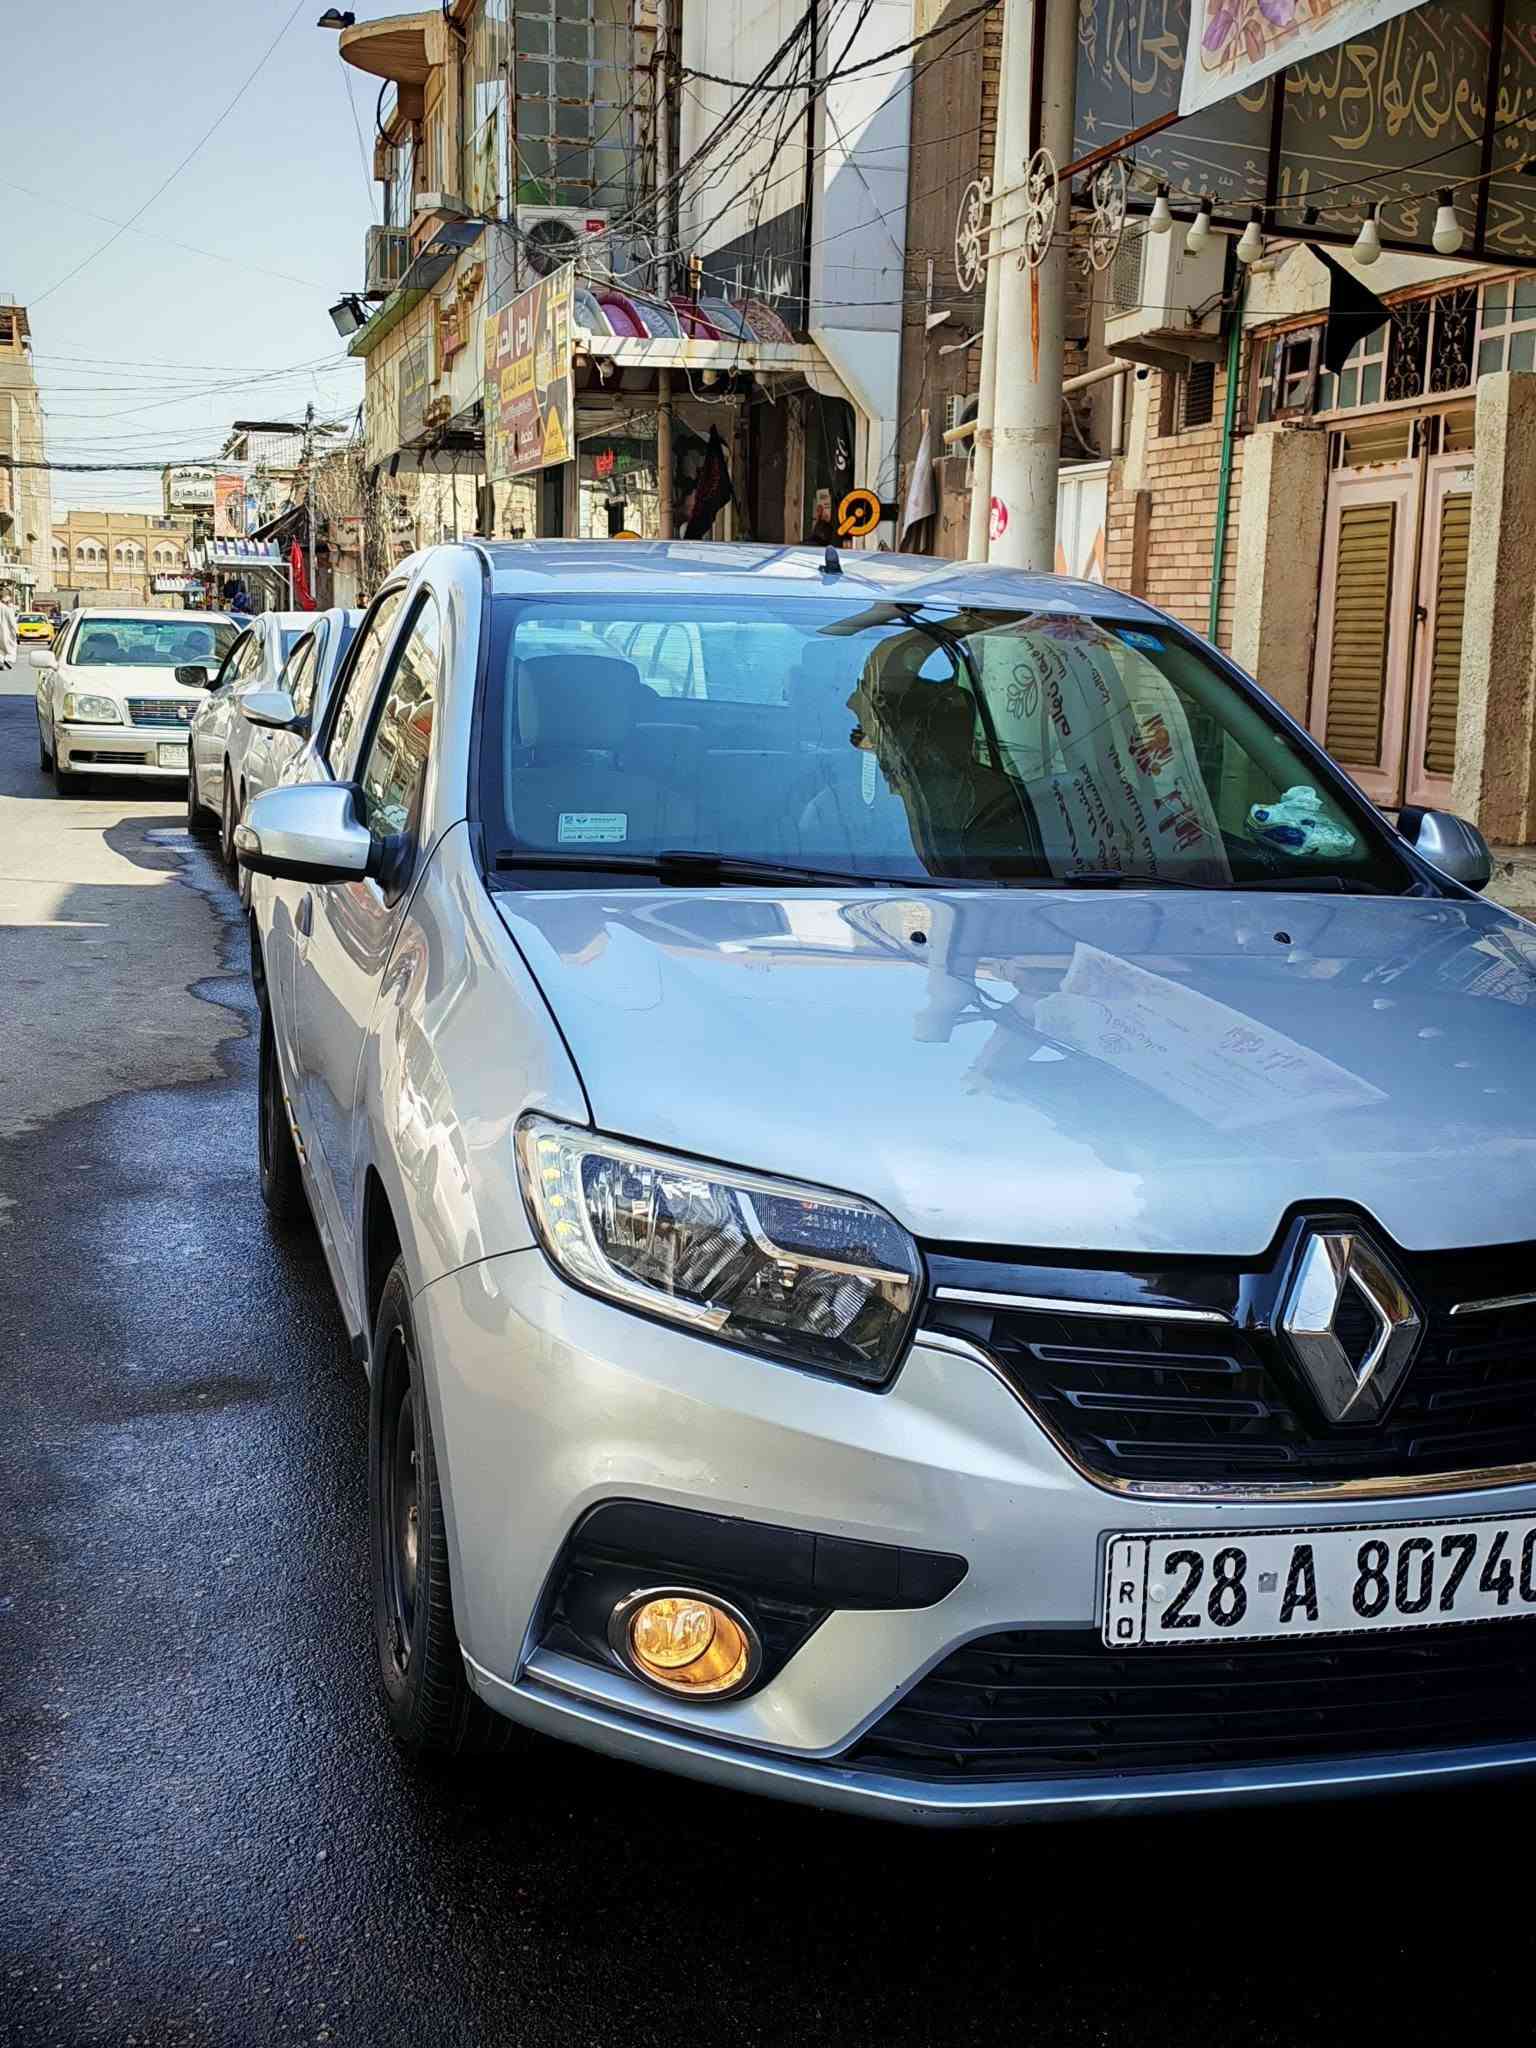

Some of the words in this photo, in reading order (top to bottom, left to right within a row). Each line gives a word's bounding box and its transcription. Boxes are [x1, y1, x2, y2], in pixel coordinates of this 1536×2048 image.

[1117, 1544, 1135, 1639] IRQ
[1161, 1547, 1247, 1629] 28
[1279, 1544, 1319, 1622] A
